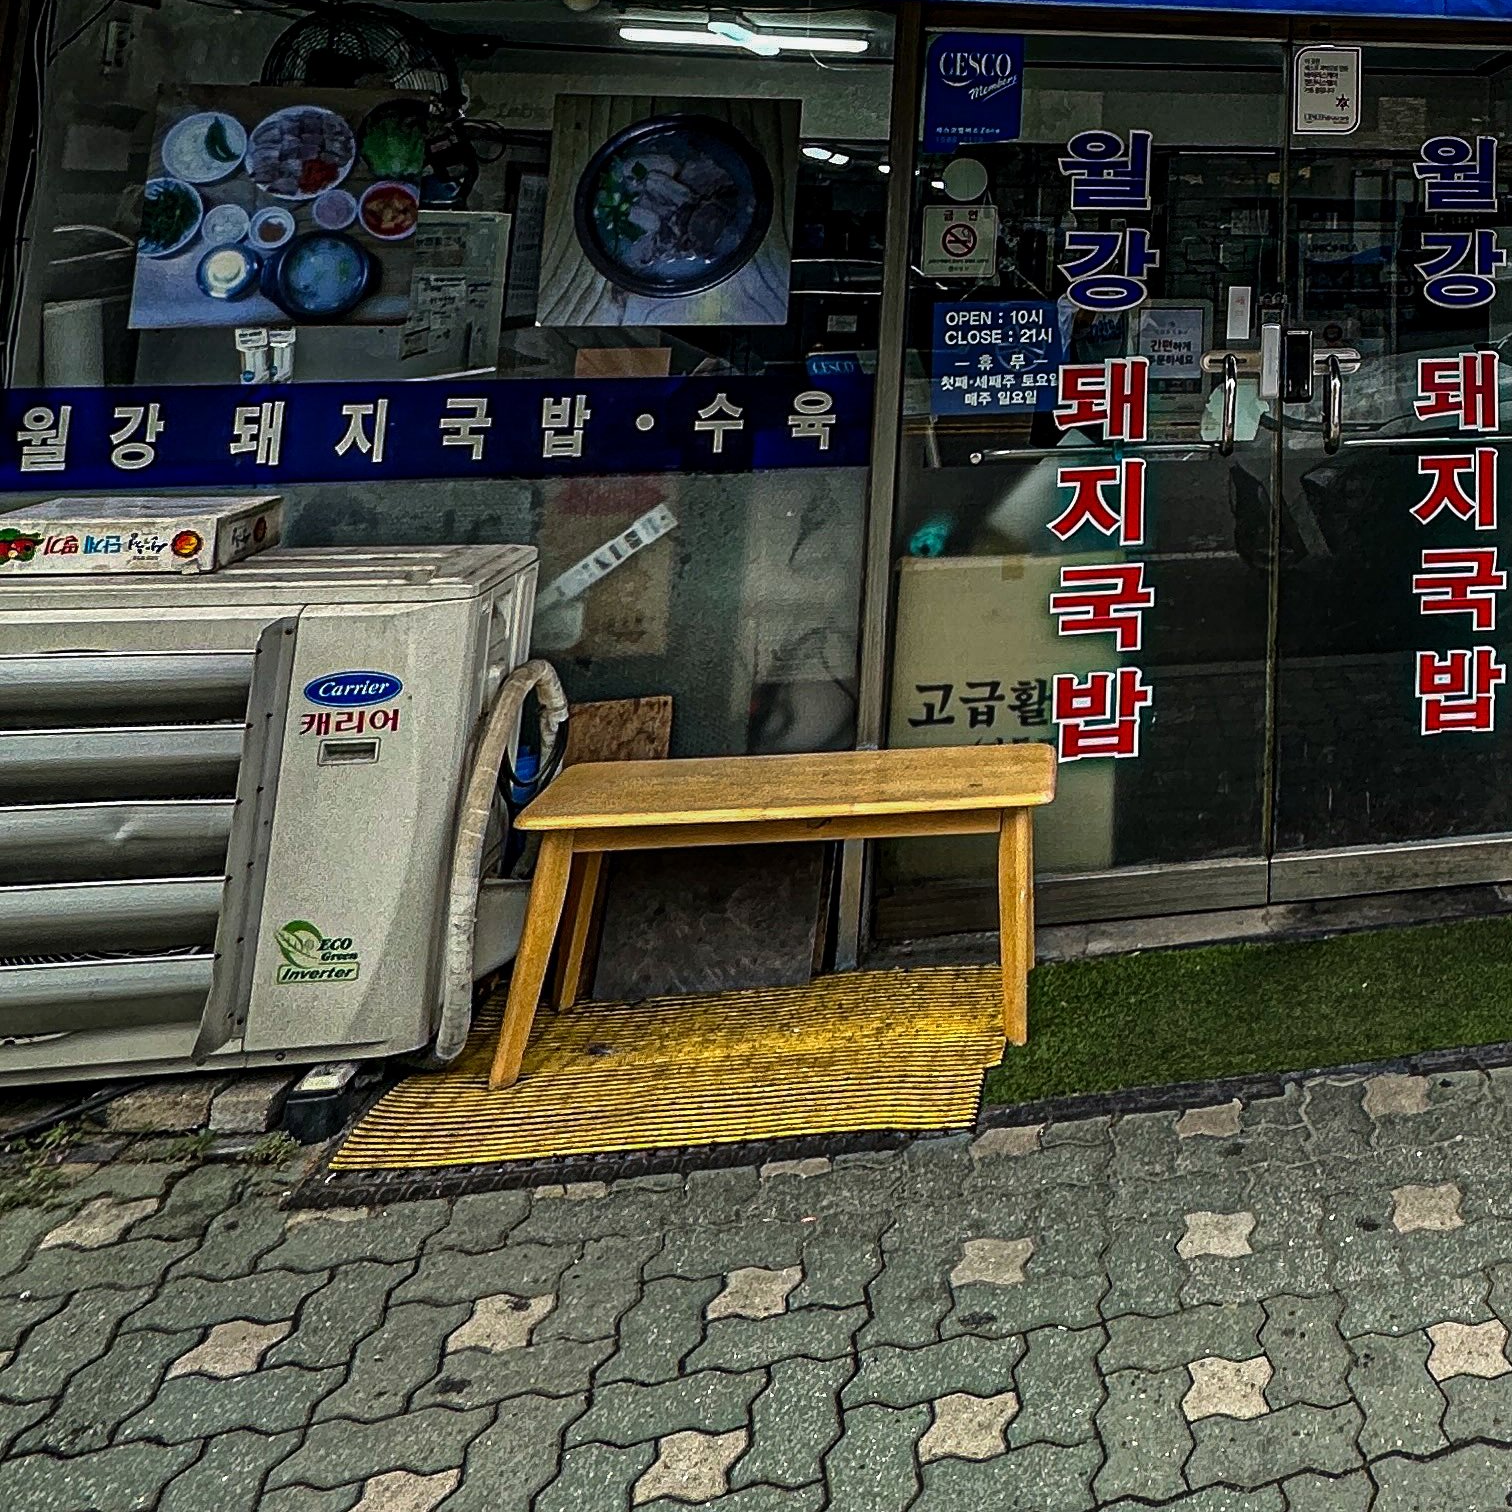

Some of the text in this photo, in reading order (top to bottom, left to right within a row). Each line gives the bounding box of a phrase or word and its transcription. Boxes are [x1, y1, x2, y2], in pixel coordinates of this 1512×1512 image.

[940, 52, 1012, 77] CESCO
[945, 309, 1043, 326] OPEN 10시
[944, 328, 1052, 345] CLOSE 21시
[964, 390, 1037, 406] 매주 일요일
[1410, 349, 1507, 736] 돼지국밥
[1046, 356, 1155, 763] 돼지국밥
[318, 680, 390, 697] Carrier
[300, 708, 399, 736] 캐리어
[317, 937, 353, 951] ECO
[282, 967, 355, 980] Inverter
